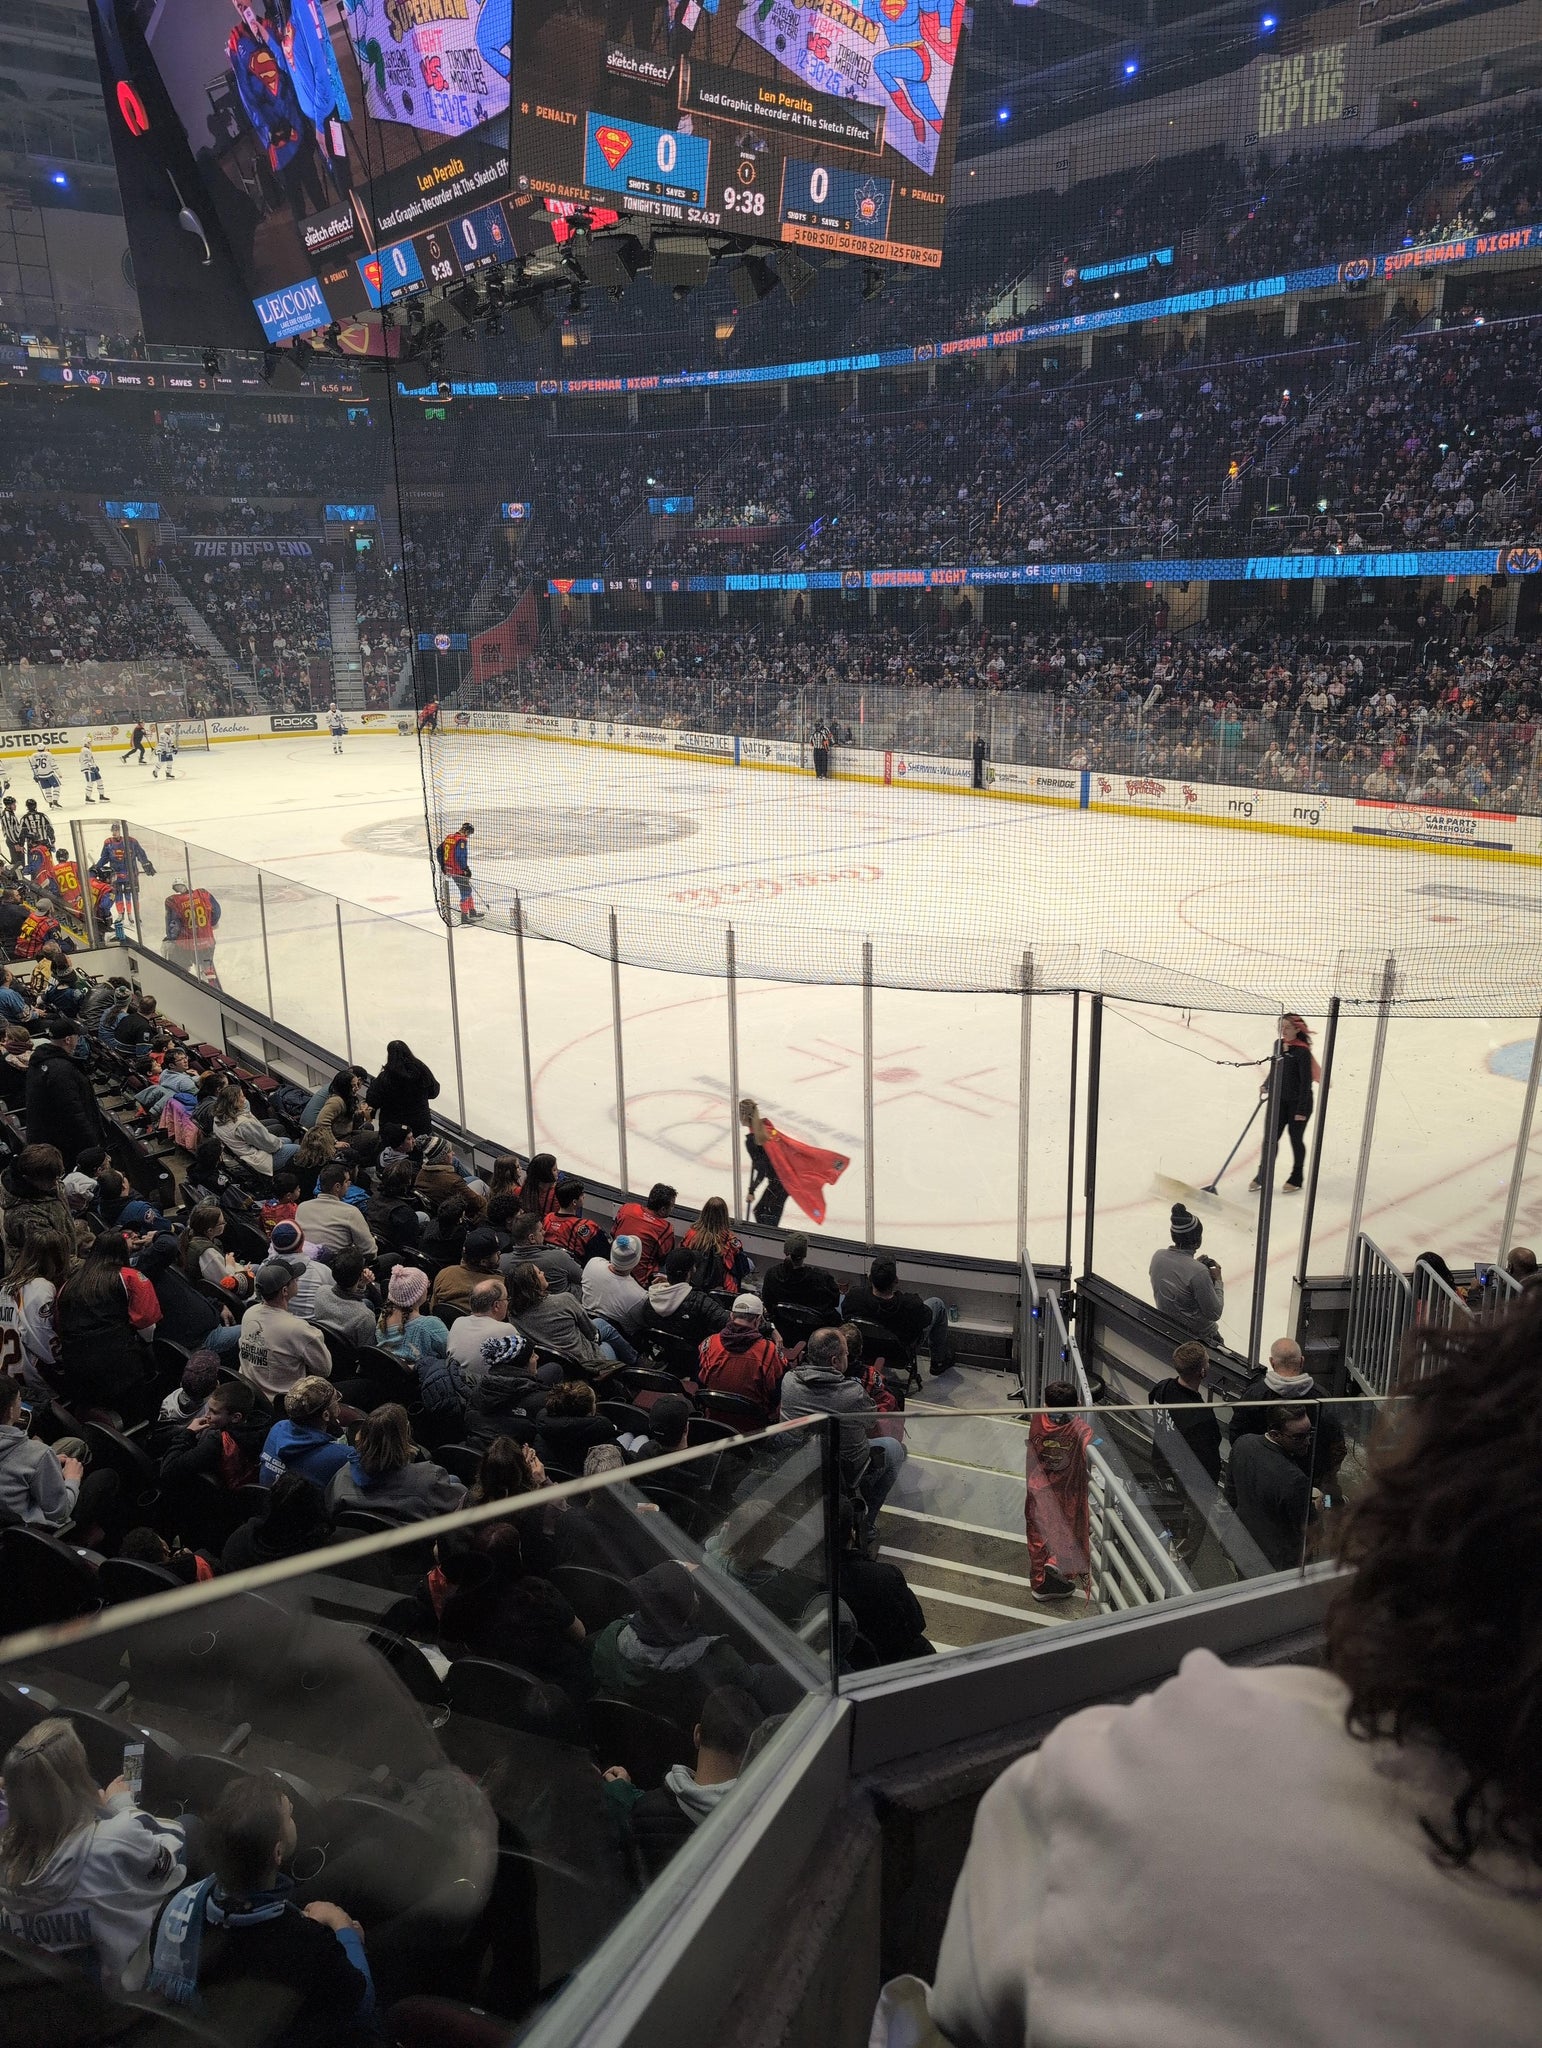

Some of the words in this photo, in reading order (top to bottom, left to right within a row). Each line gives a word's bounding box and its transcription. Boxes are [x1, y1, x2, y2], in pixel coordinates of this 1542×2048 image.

[446, 48, 482, 71] TORONTO
[606, 54, 638, 72] sketch
[838, 44, 871, 75] TORONTO
[1261, 55, 1305, 93] FEAR
[1312, 42, 1347, 77] THE
[834, 57, 870, 89] MARLIES
[759, 88, 776, 104] Len
[778, 93, 814, 113] Peralta
[1258, 71, 1344, 138] DEPTHS
[536, 105, 577, 126] PENALTY
[699, 89, 720, 105] Lead
[721, 96, 753, 113] Graphic
[754, 103, 791, 121] Recorder
[791, 111, 801, 124] At
[803, 115, 817, 129] The
[818, 118, 845, 134] Sketch
[846, 125, 870, 141] Effect
[656, 133, 677, 173] 0
[416, 175, 435, 192] Len
[433, 158, 465, 184] Peralta
[744, 168, 749, 178] 1
[530, 178, 557, 193] 50/50
[558, 185, 591, 201] RAFFLE
[628, 180, 650, 192] SHOTS
[655, 184, 662, 194] 5
[665, 186, 686, 199] SAVES
[691, 191, 698, 201] 3
[810, 167, 829, 204] 0
[911, 189, 945, 204] PENALTY
[378, 214, 395, 230] Lead
[395, 201, 423, 222] Graphic
[421, 189, 453, 214] Recorder
[453, 183, 463, 197] At
[460, 178, 476, 194] The
[474, 165, 498, 187] Sketch
[724, 187, 765, 216] 9:38
[623, 196, 660, 215] TONIGHT'S
[661, 203, 683, 220] TOTAL
[687, 207, 720, 226] $2,437
[787, 211, 807, 222] SHOTS
[812, 215, 817, 224] 3
[821, 217, 839, 228] SAVES
[844, 221, 850, 230] 5
[304, 227, 328, 247] sketch
[462, 218, 478, 251] 0
[794, 228, 800, 239] 5
[802, 231, 818, 243] FOR
[820, 233, 834, 246] $10
[839, 237, 850, 248] 50
[851, 239, 867, 251] FOR
[869, 242, 885, 255] $20
[890, 245, 904, 258] 125
[905, 248, 921, 261] FOR
[922, 251, 938, 264] $40
[1385, 243, 1466, 272] SUPERMAN
[1476, 228, 1532, 255] NIGHT
[392, 247, 408, 278] 0
[431, 260, 453, 281] 9:38
[1080, 265, 1107, 281] FORGED
[1126, 257, 1148, 270] LAND
[1165, 290, 1214, 314] FORGED
[1249, 276, 1286, 298] LAND
[940, 335, 987, 355] SUPERMAN
[993, 328, 1025, 345] NIGHT
[1074, 315, 1086, 326] GE
[852, 353, 881, 371] LAND
[63, 368, 73, 382] 0
[117, 376, 141, 385] SHOTS
[147, 377, 155, 386] 3
[170, 379, 193, 387] SAVES
[200, 379, 207, 389] 5
[321, 384, 339, 393] 6:56
[568, 379, 622, 392] SUPERMAN
[627, 376, 660, 390] NIGHT
[707, 371, 719, 380] GE
[194, 541, 227, 557] THE
[276, 541, 313, 557] END
[870, 571, 925, 587] SUPERMAN
[931, 569, 967, 584] NIGHT
[971, 571, 1010, 580] PRESENTED
[1012, 571, 1021, 579] BY
[1026, 565, 1040, 576] GE
[1043, 565, 1082, 577] Lighting
[1245, 556, 1315, 580] FORGED
[1365, 553, 1419, 577] LAND
[685, 733, 714, 749] CENTER
[717, 737, 729, 750] ICE
[36, 758, 47, 769] 76
[1036, 777, 1077, 789] ENBRIDGE
[1228, 799, 1253, 817] nrg
[1293, 807, 1320, 825] nrg
[1425, 815, 1445, 825] CAR
[1446, 817, 1477, 828] PARTS
[1426, 824, 1475, 835] WAREHOUSE
[56, 871, 78, 895] 26
[240, 1342, 268, 1357] CLEVELAND
[240, 1349, 268, 1367] BROWNS
